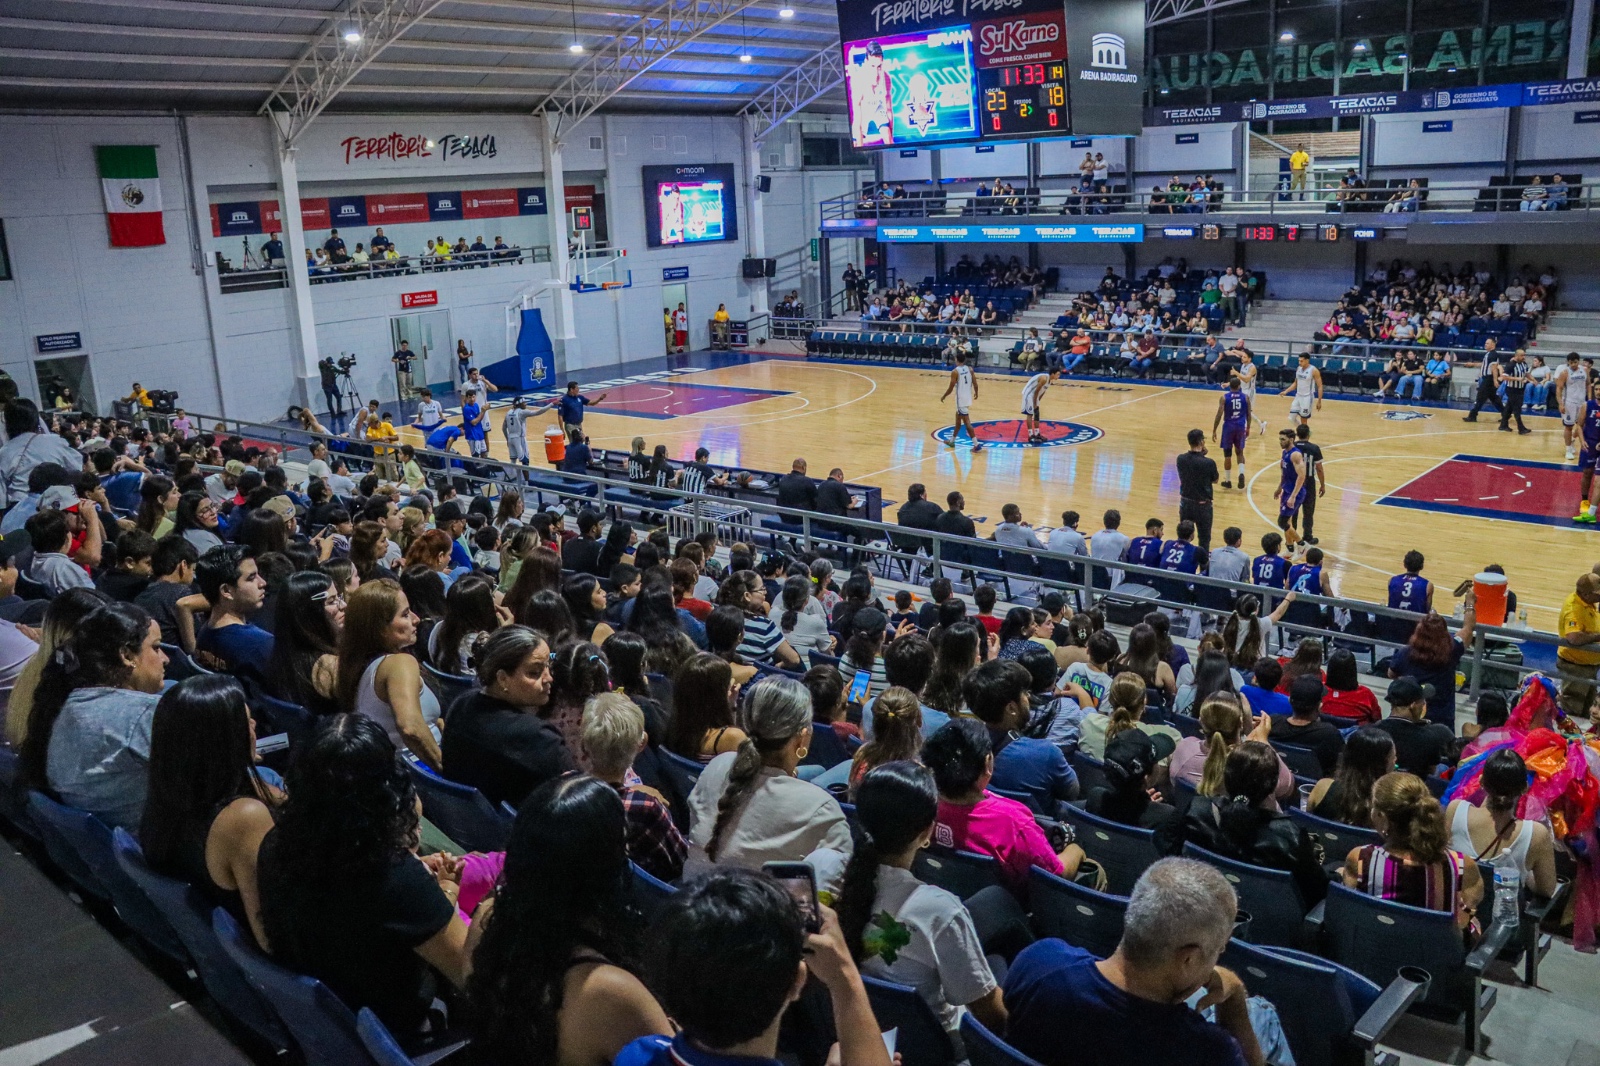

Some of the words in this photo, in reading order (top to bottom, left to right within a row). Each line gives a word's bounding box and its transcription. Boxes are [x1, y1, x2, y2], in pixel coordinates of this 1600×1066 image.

[980, 20, 1059, 55] SuKarne
[989, 57, 1003, 65] COME
[1004, 55, 1023, 63] FRESCO,
[1024, 53, 1038, 61] COME
[1039, 51, 1052, 59] BIEN
[1005, 64, 1046, 85] 11:33
[1052, 66, 1063, 79] 14
[1080, 70, 1099, 81] ARENA
[1100, 71, 1138, 83] BADIRAGUATO
[987, 91, 1007, 111] 23
[1049, 86, 1064, 106] 18
[1329, 95, 1397, 110] TEBACAS
[1452, 96, 1499, 105] BADIRAGUATO
[1020, 103, 1028, 117] 2
[1163, 107, 1221, 119] TEBACAS
[993, 116, 1001, 131] 0
[1049, 112, 1057, 127] 0
[579, 215, 590, 227] 14
[1204, 227, 1218, 239] 23
[1245, 227, 1274, 240] 11:33
[1288, 227, 1297, 240] 2
[1325, 227, 1337, 240] 18
[1231, 399, 1242, 410] 15
[1140, 545, 1147, 560] 1
[1165, 548, 1185, 564] 23
[1259, 563, 1274, 579] 18
[1402, 582, 1413, 598] 3
